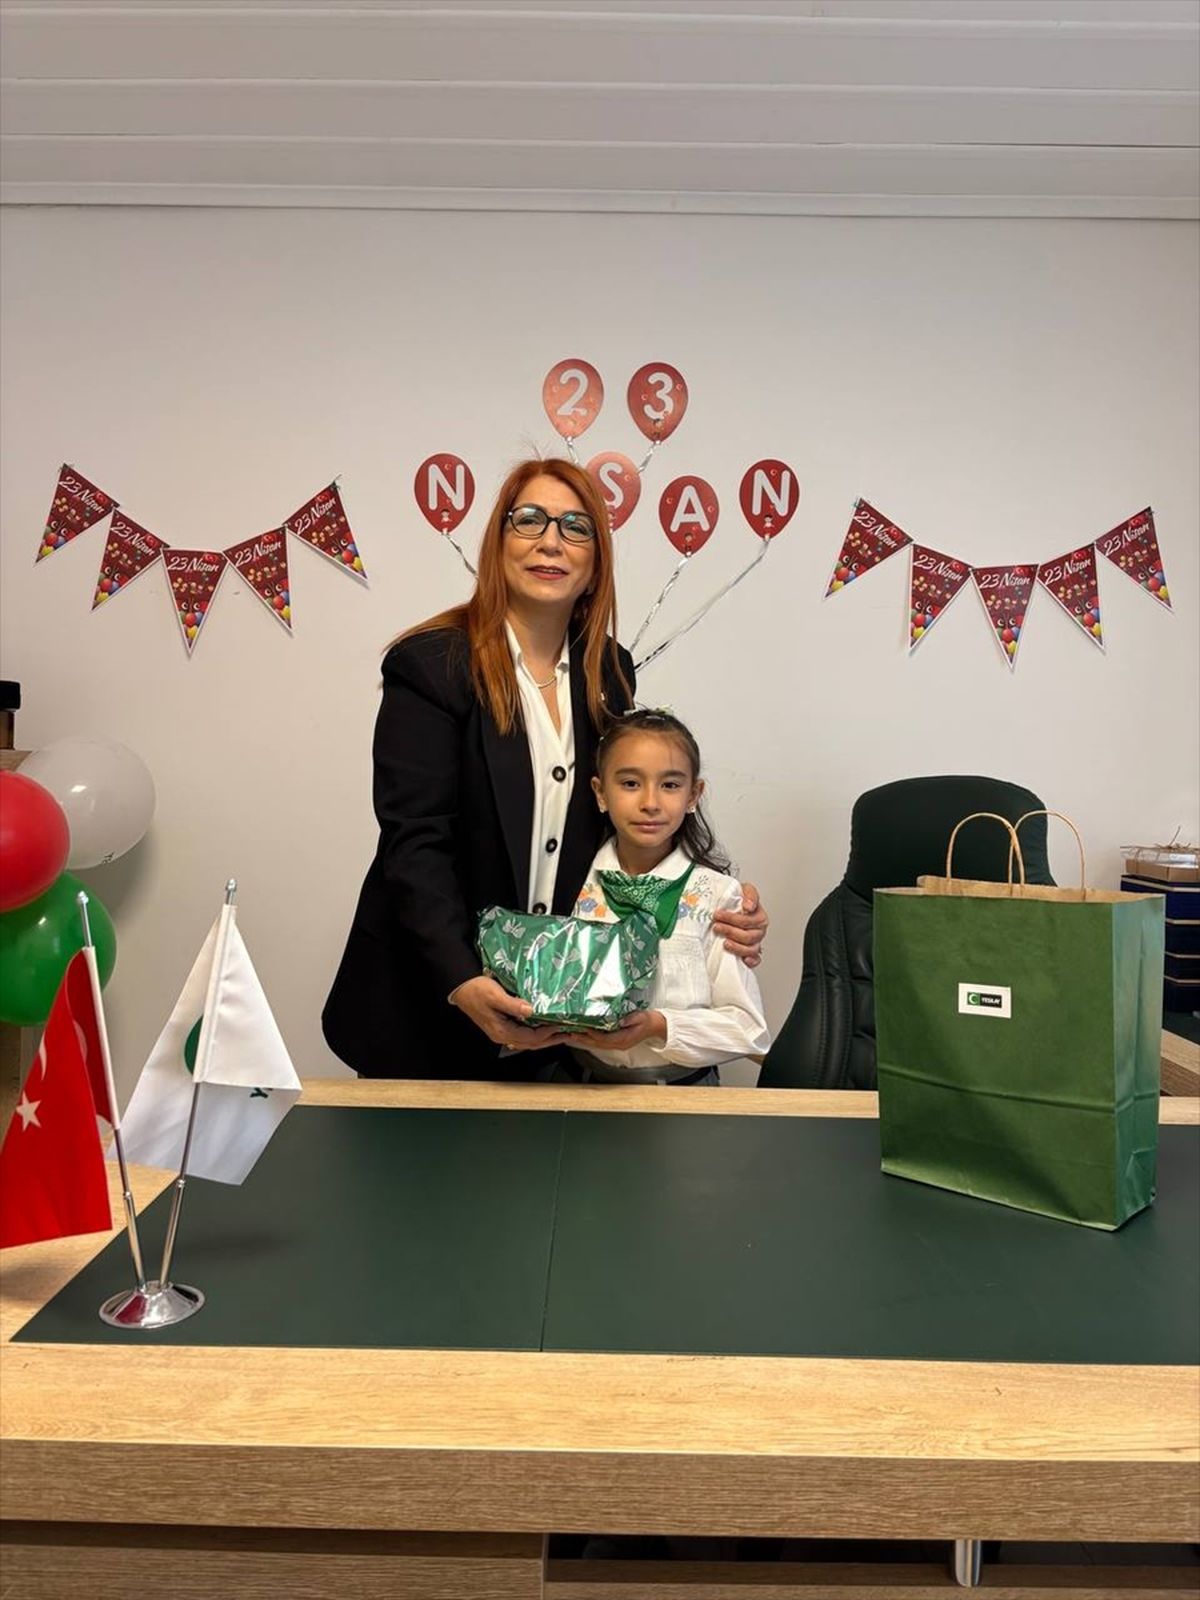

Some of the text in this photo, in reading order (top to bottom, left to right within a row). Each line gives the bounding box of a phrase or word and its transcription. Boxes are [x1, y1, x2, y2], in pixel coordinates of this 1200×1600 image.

[556, 368, 673, 421] 2 3
[59, 476, 105, 514] 23 Nisan
[294, 498, 337, 536] 23 Nisan
[854, 511, 898, 549] 23 Nisan
[110, 521, 155, 556] 23 Nisan
[234, 541, 282, 567] 23 Nisan
[1104, 523, 1151, 557] 23 Nisan
[167, 556, 220, 572] 23 Nisan
[913, 554, 964, 582] 23 Nisan
[979, 572, 1031, 589] 23 Nisan
[1044, 558, 1092, 586] 23 Nisan
